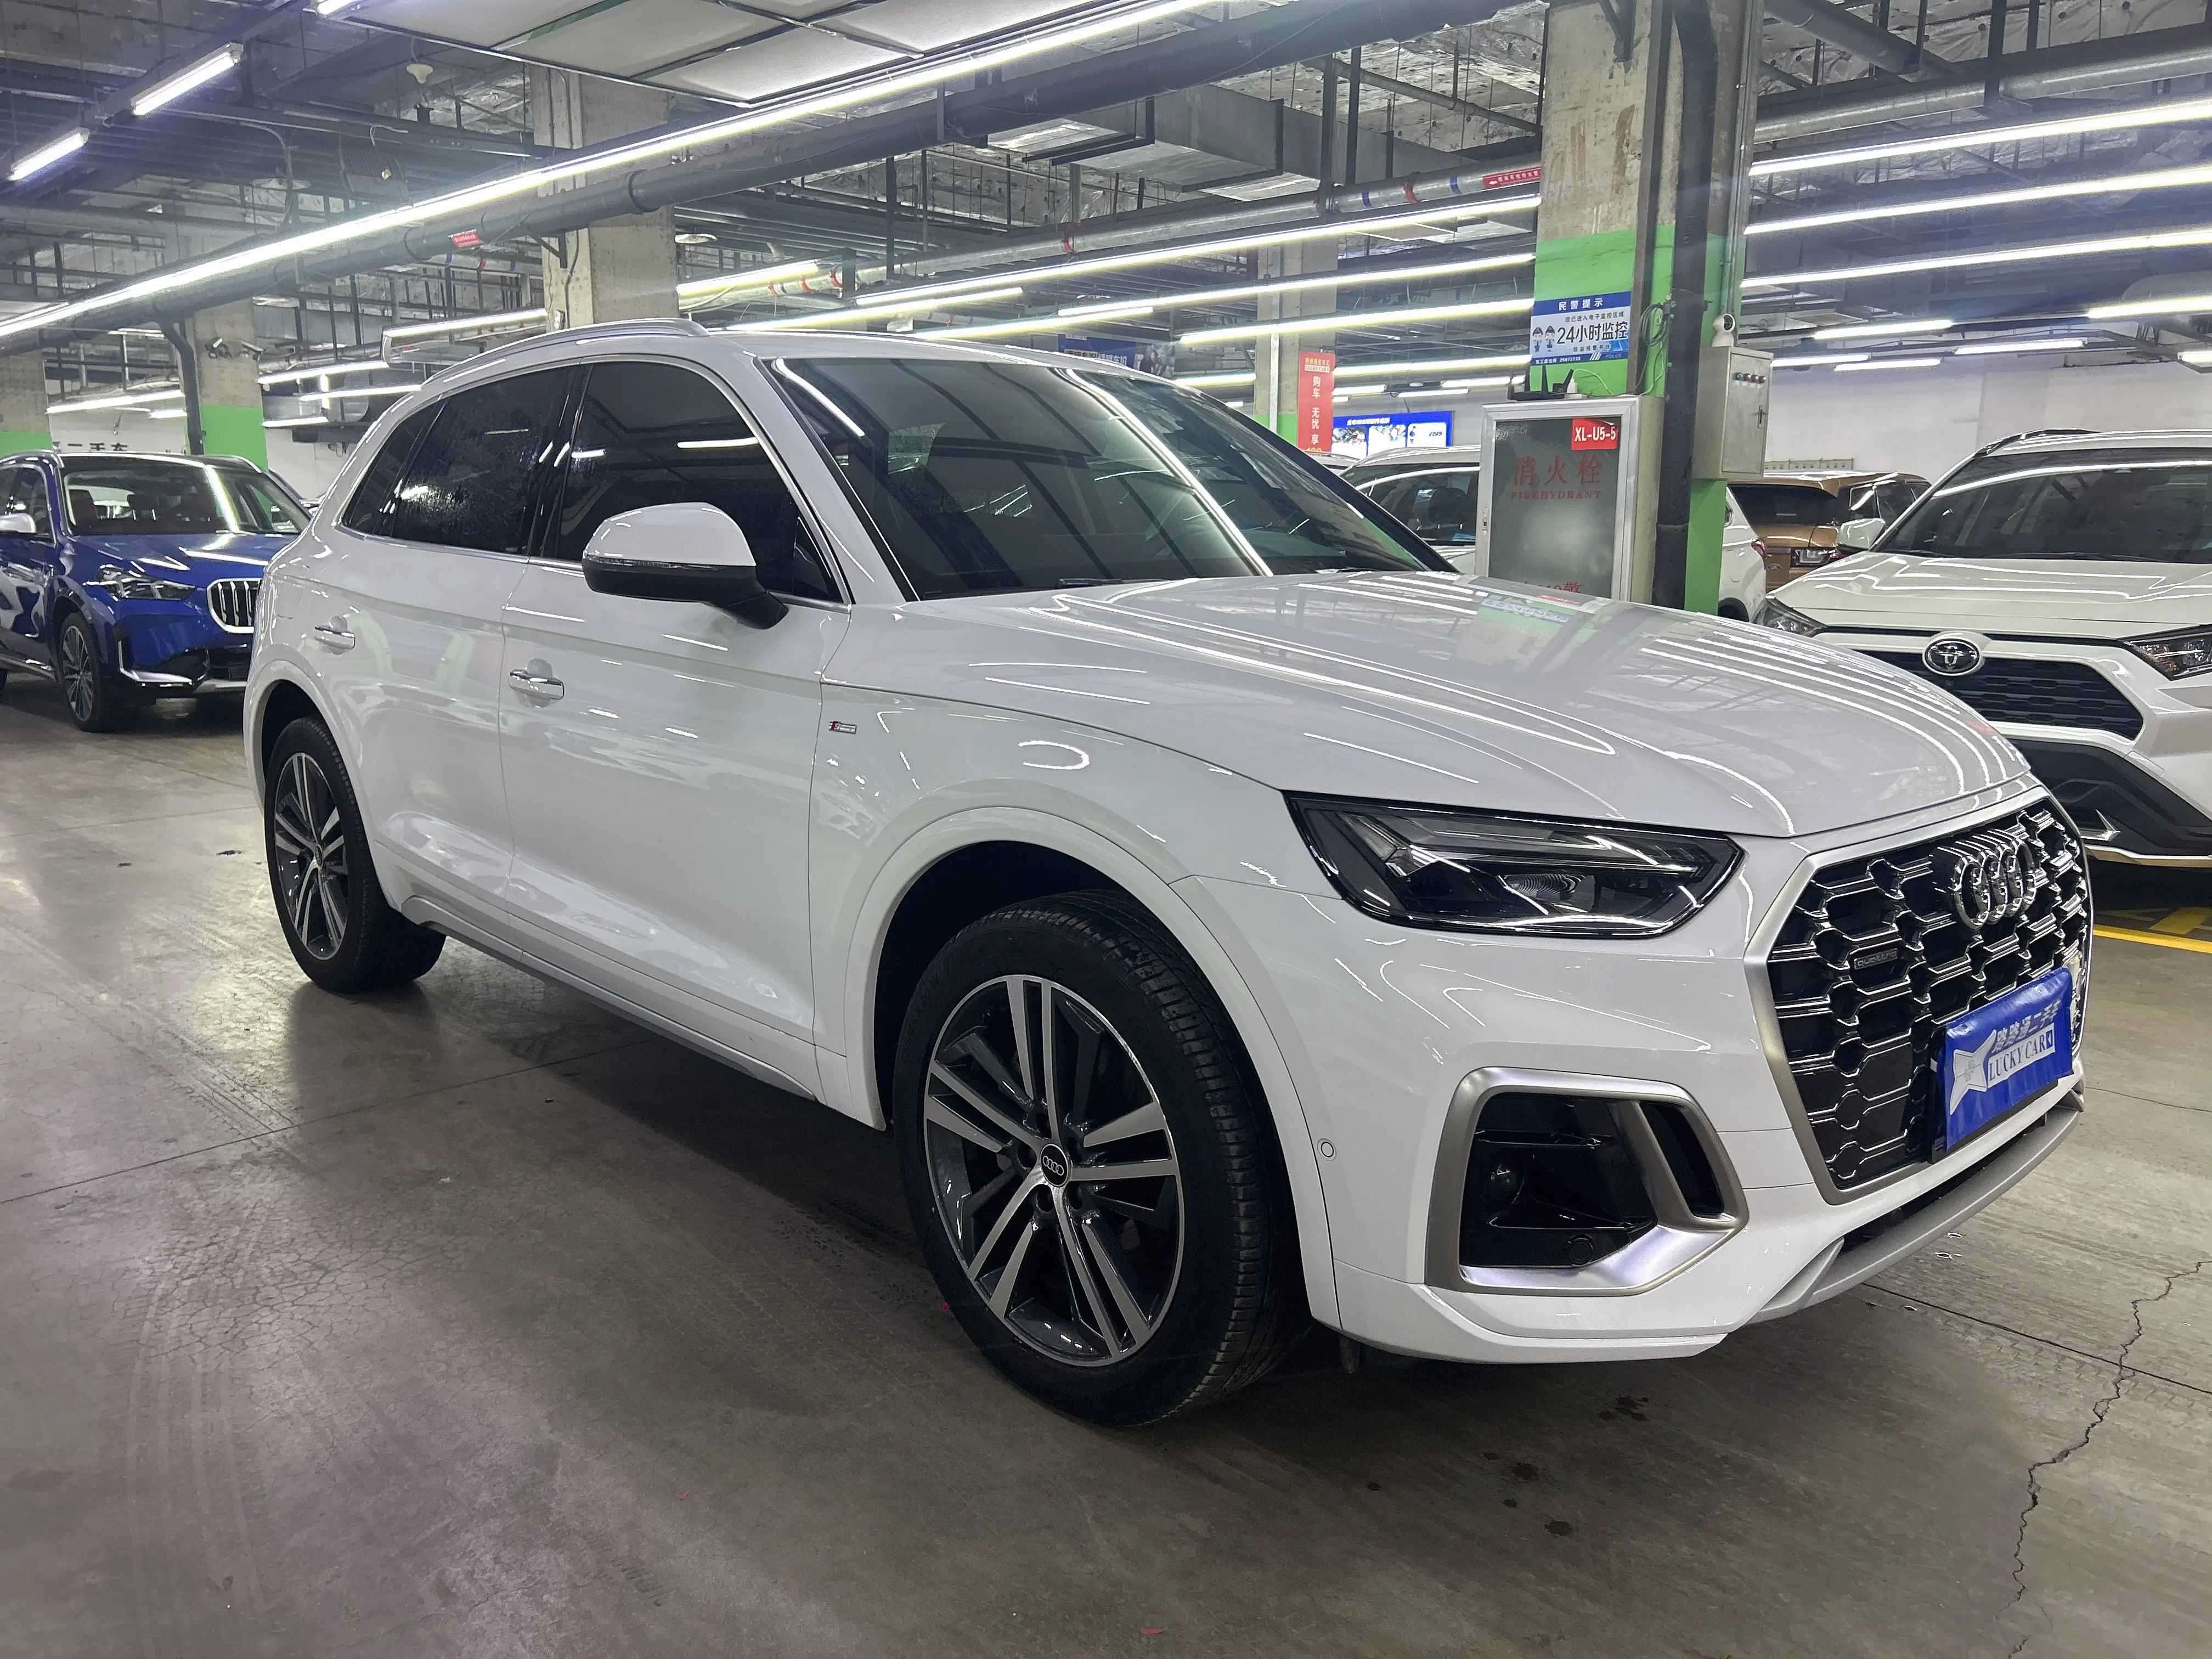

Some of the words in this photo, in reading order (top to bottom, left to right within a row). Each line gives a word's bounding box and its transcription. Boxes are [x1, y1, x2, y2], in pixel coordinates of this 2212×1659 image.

[1559, 297, 1603, 311] 民警提示
[1565, 311, 1624, 323] 您已进入电子监控区域
[1557, 320, 1628, 345] 24小时监控
[1312, 375, 1321, 399] 购车
[1311, 407, 1319, 430] 无忧
[1311, 433, 1319, 445] 享
[1574, 426, 1616, 442] XL-U5-5
[1513, 453, 1603, 486] 消火栓
[1857, 951, 1897, 966] quattro
[1991, 1000, 2061, 1053] 路路通二手车
[1989, 1045, 2024, 1081] LUCKY
